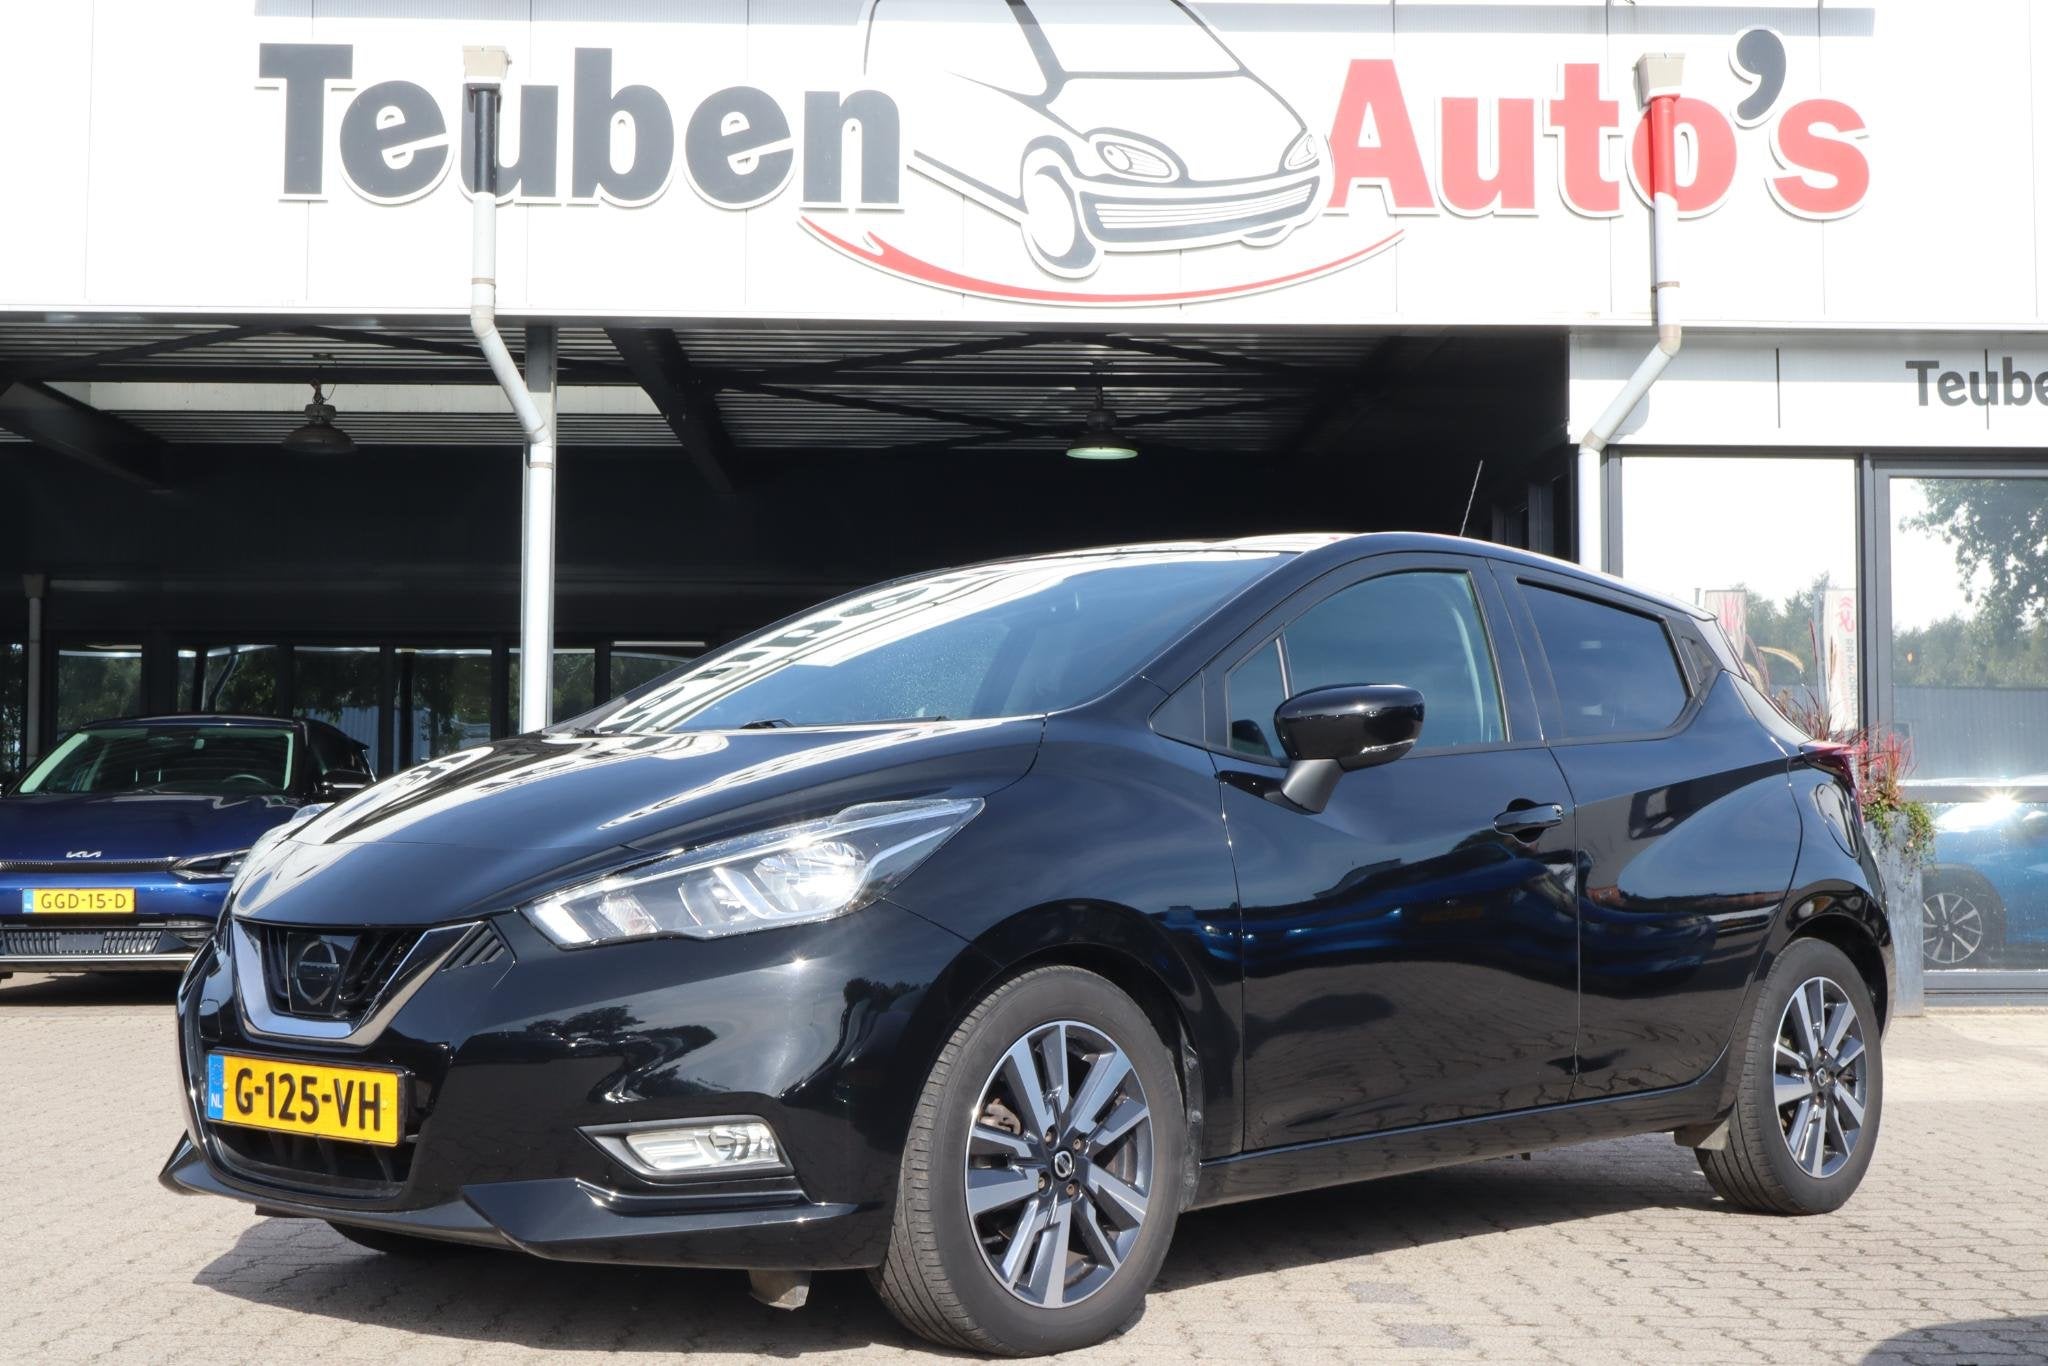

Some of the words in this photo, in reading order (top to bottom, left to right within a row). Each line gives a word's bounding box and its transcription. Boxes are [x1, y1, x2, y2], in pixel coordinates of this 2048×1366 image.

[258, 42, 900, 204] Teuben
[1328, 28, 1871, 213] Auto's
[41, 893, 126, 909] GGD-15-D
[210, 1093, 223, 1108] NL
[235, 1067, 381, 1132] G-125-VH
